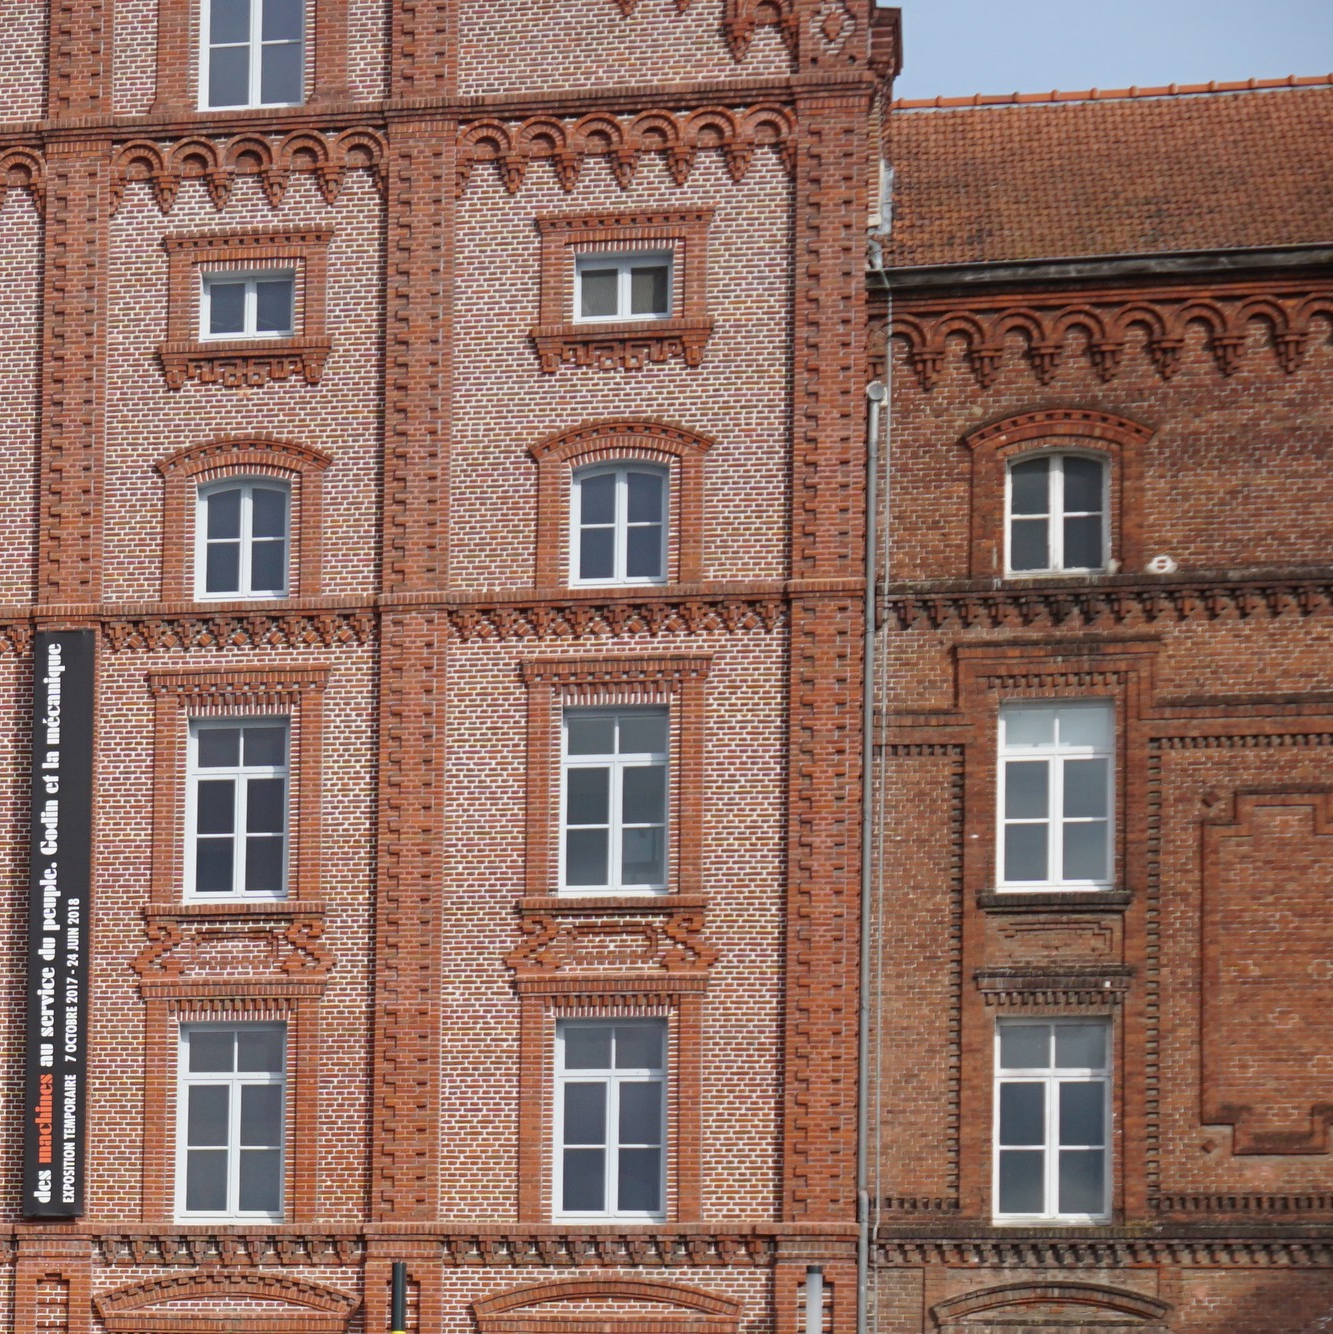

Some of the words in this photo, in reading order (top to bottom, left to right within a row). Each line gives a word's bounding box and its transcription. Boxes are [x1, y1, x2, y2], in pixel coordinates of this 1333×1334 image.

[41, 643, 66, 745] mécanique
[41, 751, 60, 769] la
[41, 774, 60, 794] et
[39, 799, 59, 856] Godin
[38, 861, 62, 931] peuple.
[67, 897, 80, 925] 2018
[37, 937, 56, 962] du
[66, 927, 79, 952] JUIN
[66, 953, 79, 968] 24
[36, 966, 56, 1038] service
[65, 977, 79, 1004] 2017
[64, 1005, 78, 1053] OCTOBRE
[40, 1043, 54, 1068] au
[64, 1054, 77, 1062] 7
[34, 1073, 54, 1164] machines
[63, 1074, 77, 1140] TEMPORAIRE
[33, 1169, 52, 1204] des
[62, 1141, 76, 1203] EXPOSITION
